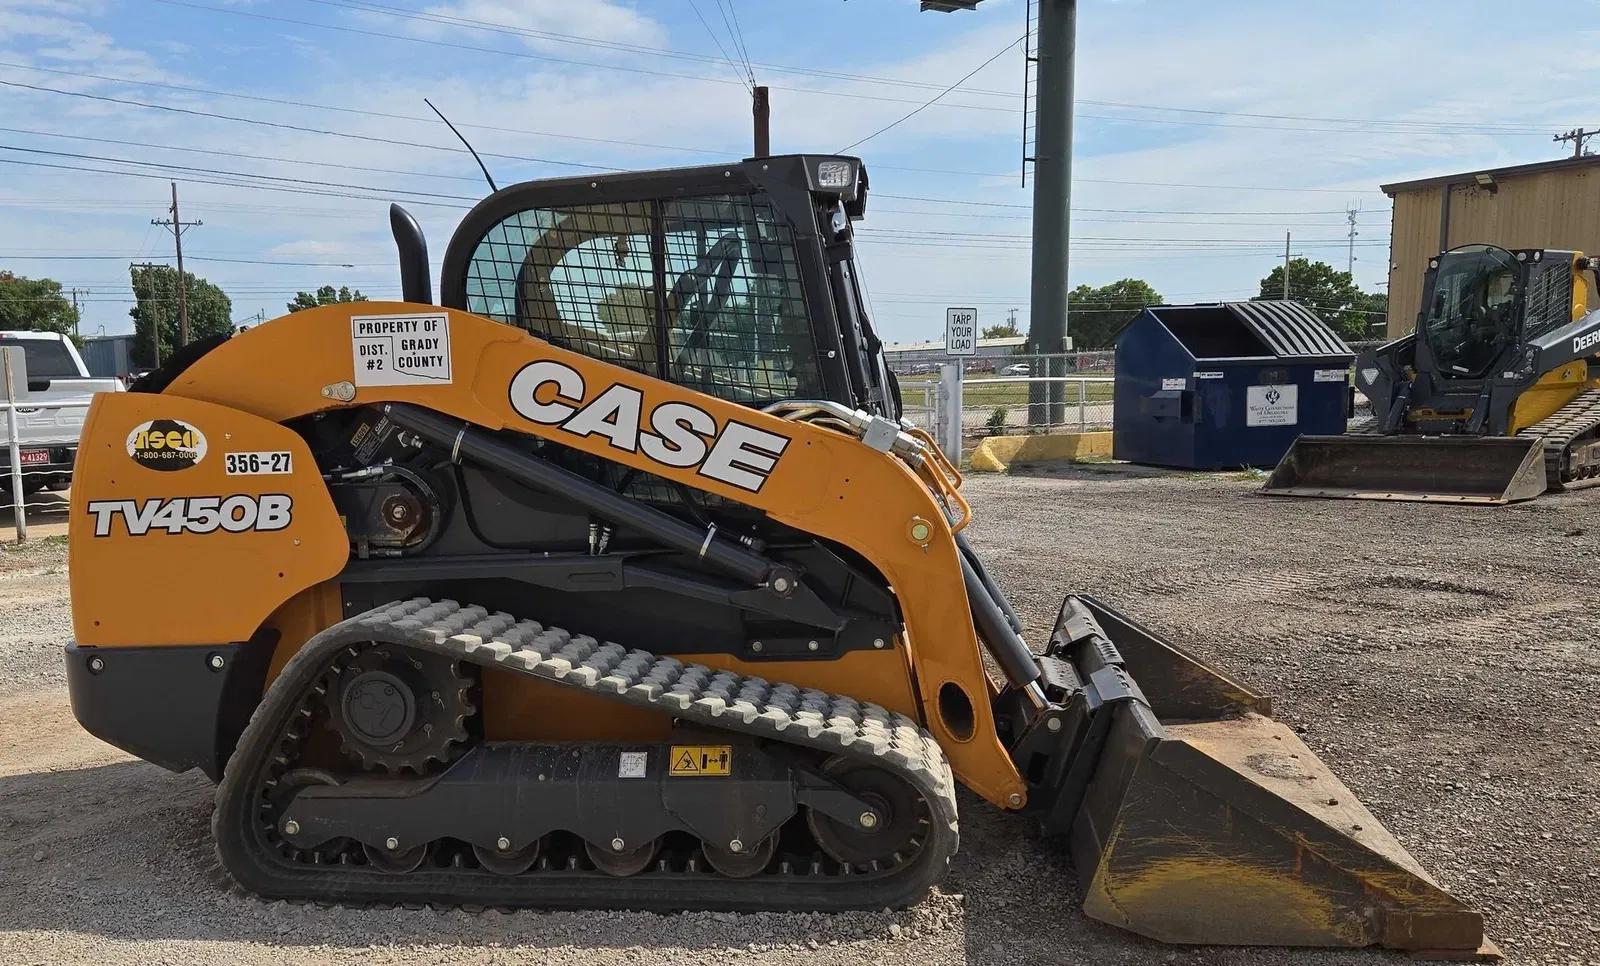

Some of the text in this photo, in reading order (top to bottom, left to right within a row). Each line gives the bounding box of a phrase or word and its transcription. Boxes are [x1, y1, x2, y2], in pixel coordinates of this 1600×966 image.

[953, 314, 972, 324] TARP
[359, 320, 438, 334] PROPERTY OF
[951, 327, 972, 337] YOUR
[402, 338, 439, 350] GRADY
[951, 339, 971, 350] LOAD
[1573, 329, 1600, 353] DEER
[360, 344, 388, 356] DIST.
[367, 359, 383, 370] #2
[398, 356, 443, 368] COUNTY
[508, 359, 792, 494] CASE
[227, 454, 291, 474] 356-27
[88, 493, 293, 537] TV450B
